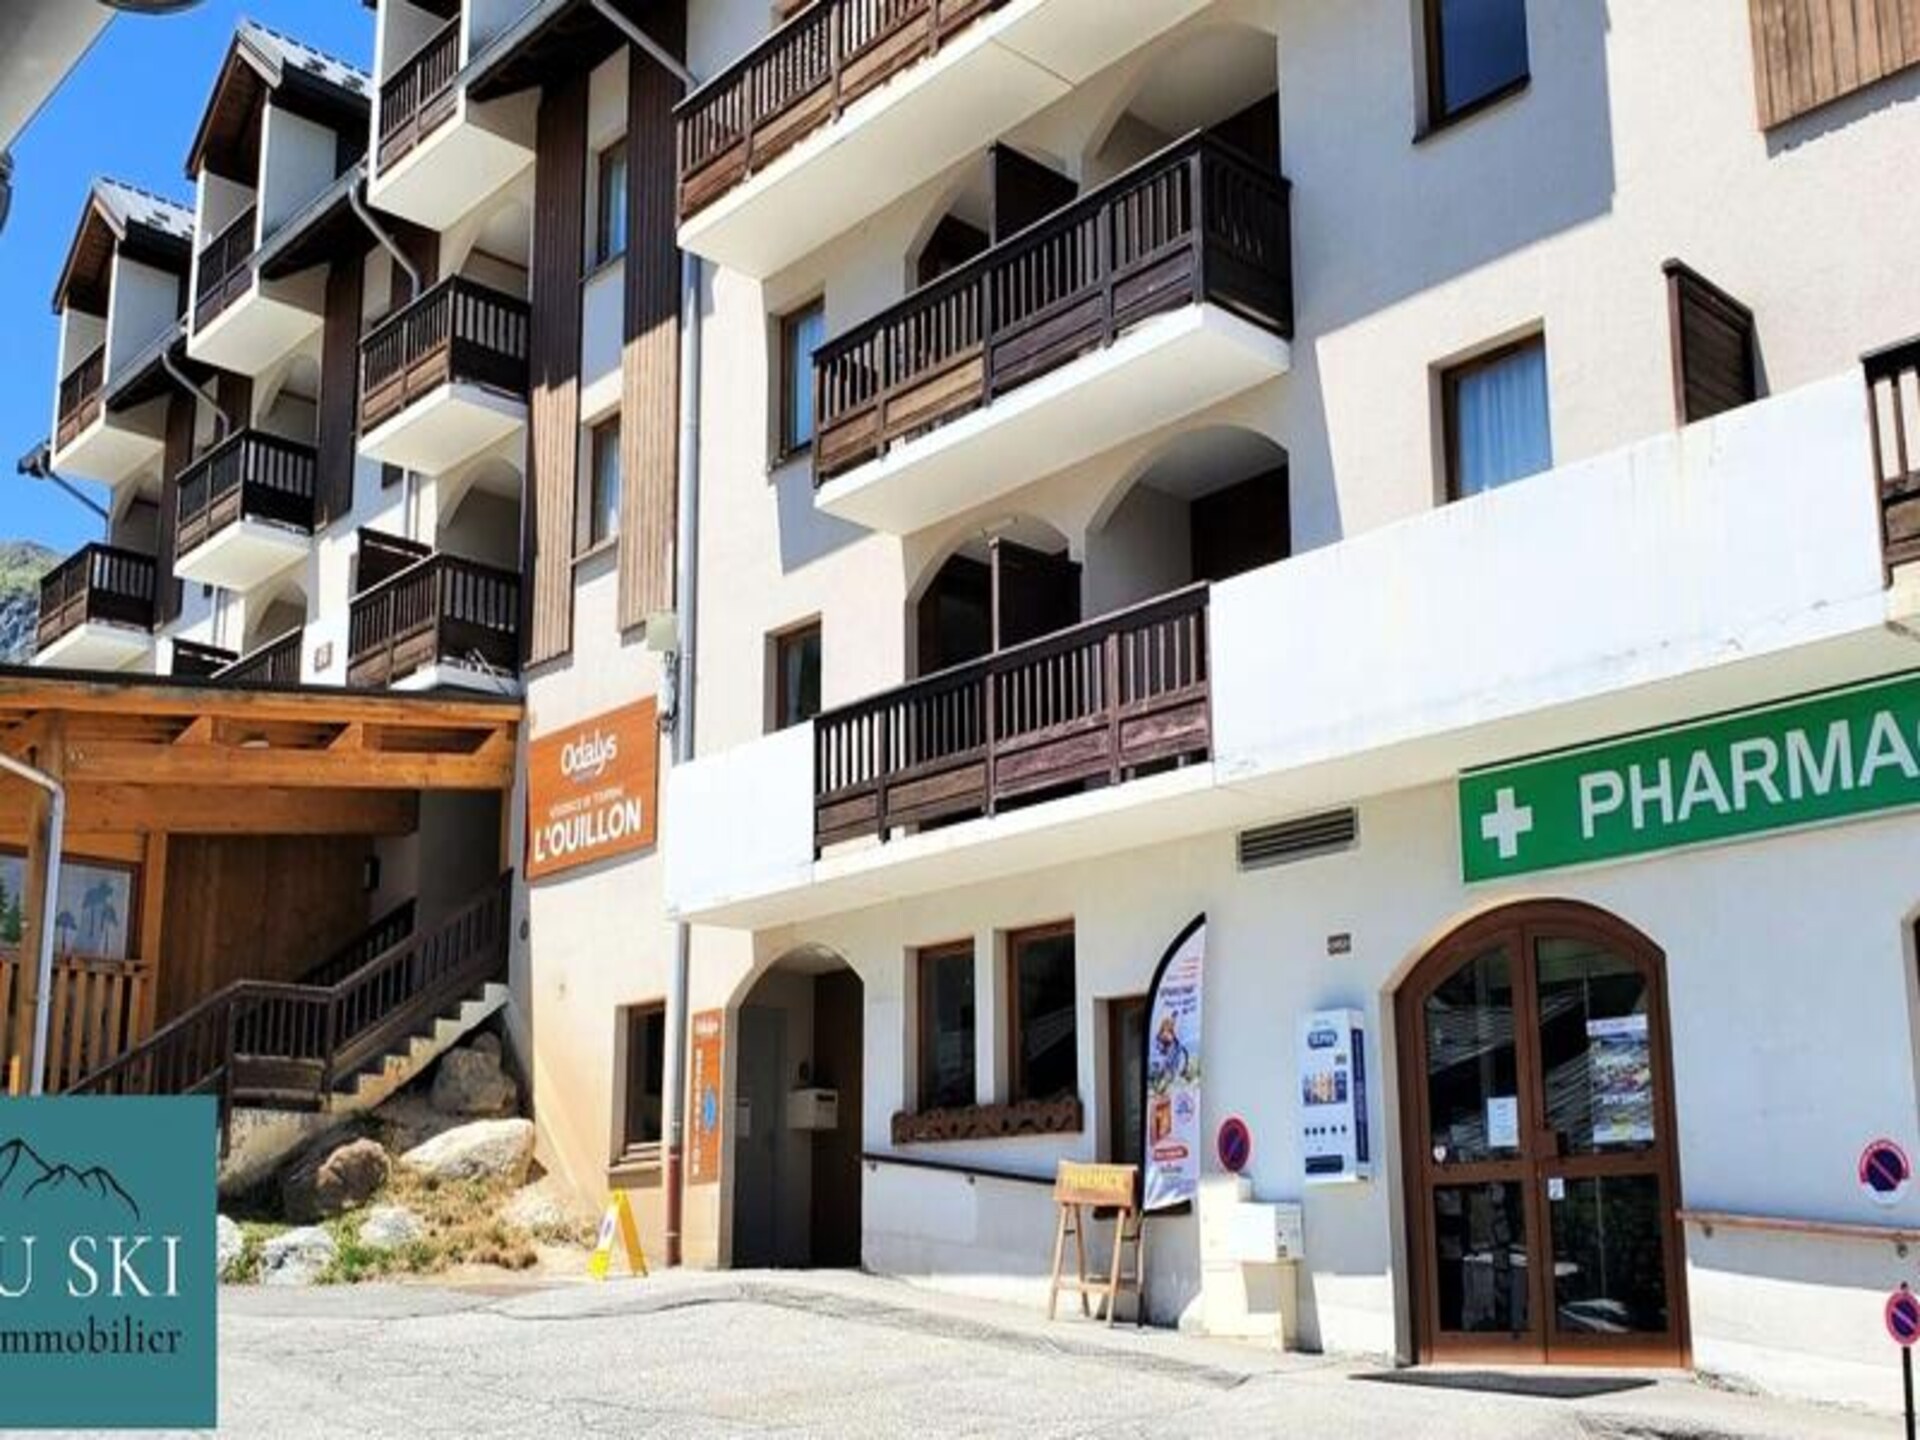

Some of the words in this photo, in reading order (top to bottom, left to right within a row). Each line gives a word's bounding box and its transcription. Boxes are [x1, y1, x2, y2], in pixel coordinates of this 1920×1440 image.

[561, 729, 618, 776] Odalys
[1578, 709, 1920, 839] PHARMA
[535, 797, 641, 861] L'OUILLON
